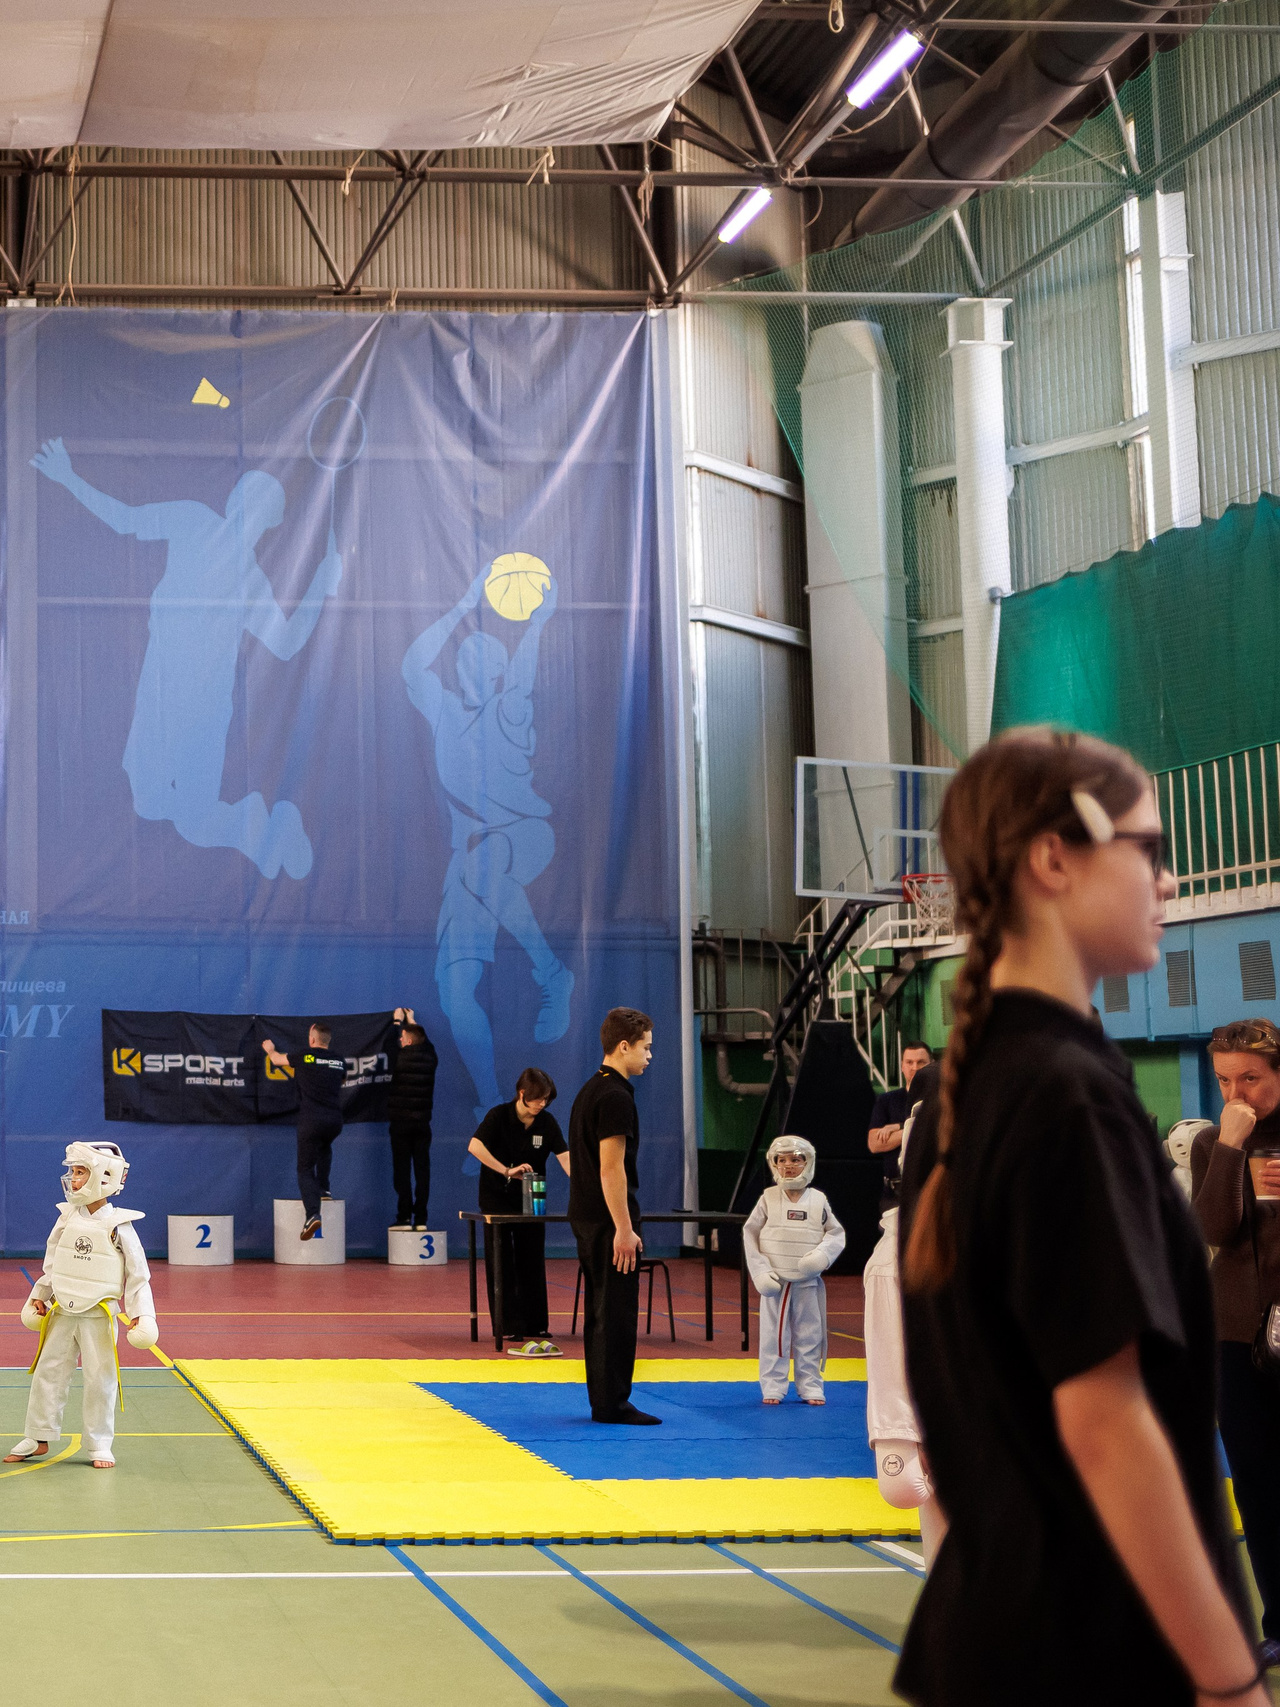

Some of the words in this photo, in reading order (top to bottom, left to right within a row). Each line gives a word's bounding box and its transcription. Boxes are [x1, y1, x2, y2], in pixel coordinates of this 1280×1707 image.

[185, 1076, 221, 1087] martial
[223, 1077, 246, 1087] arts
[195, 1224, 213, 1249] 2
[419, 1234, 436, 1260] 3
